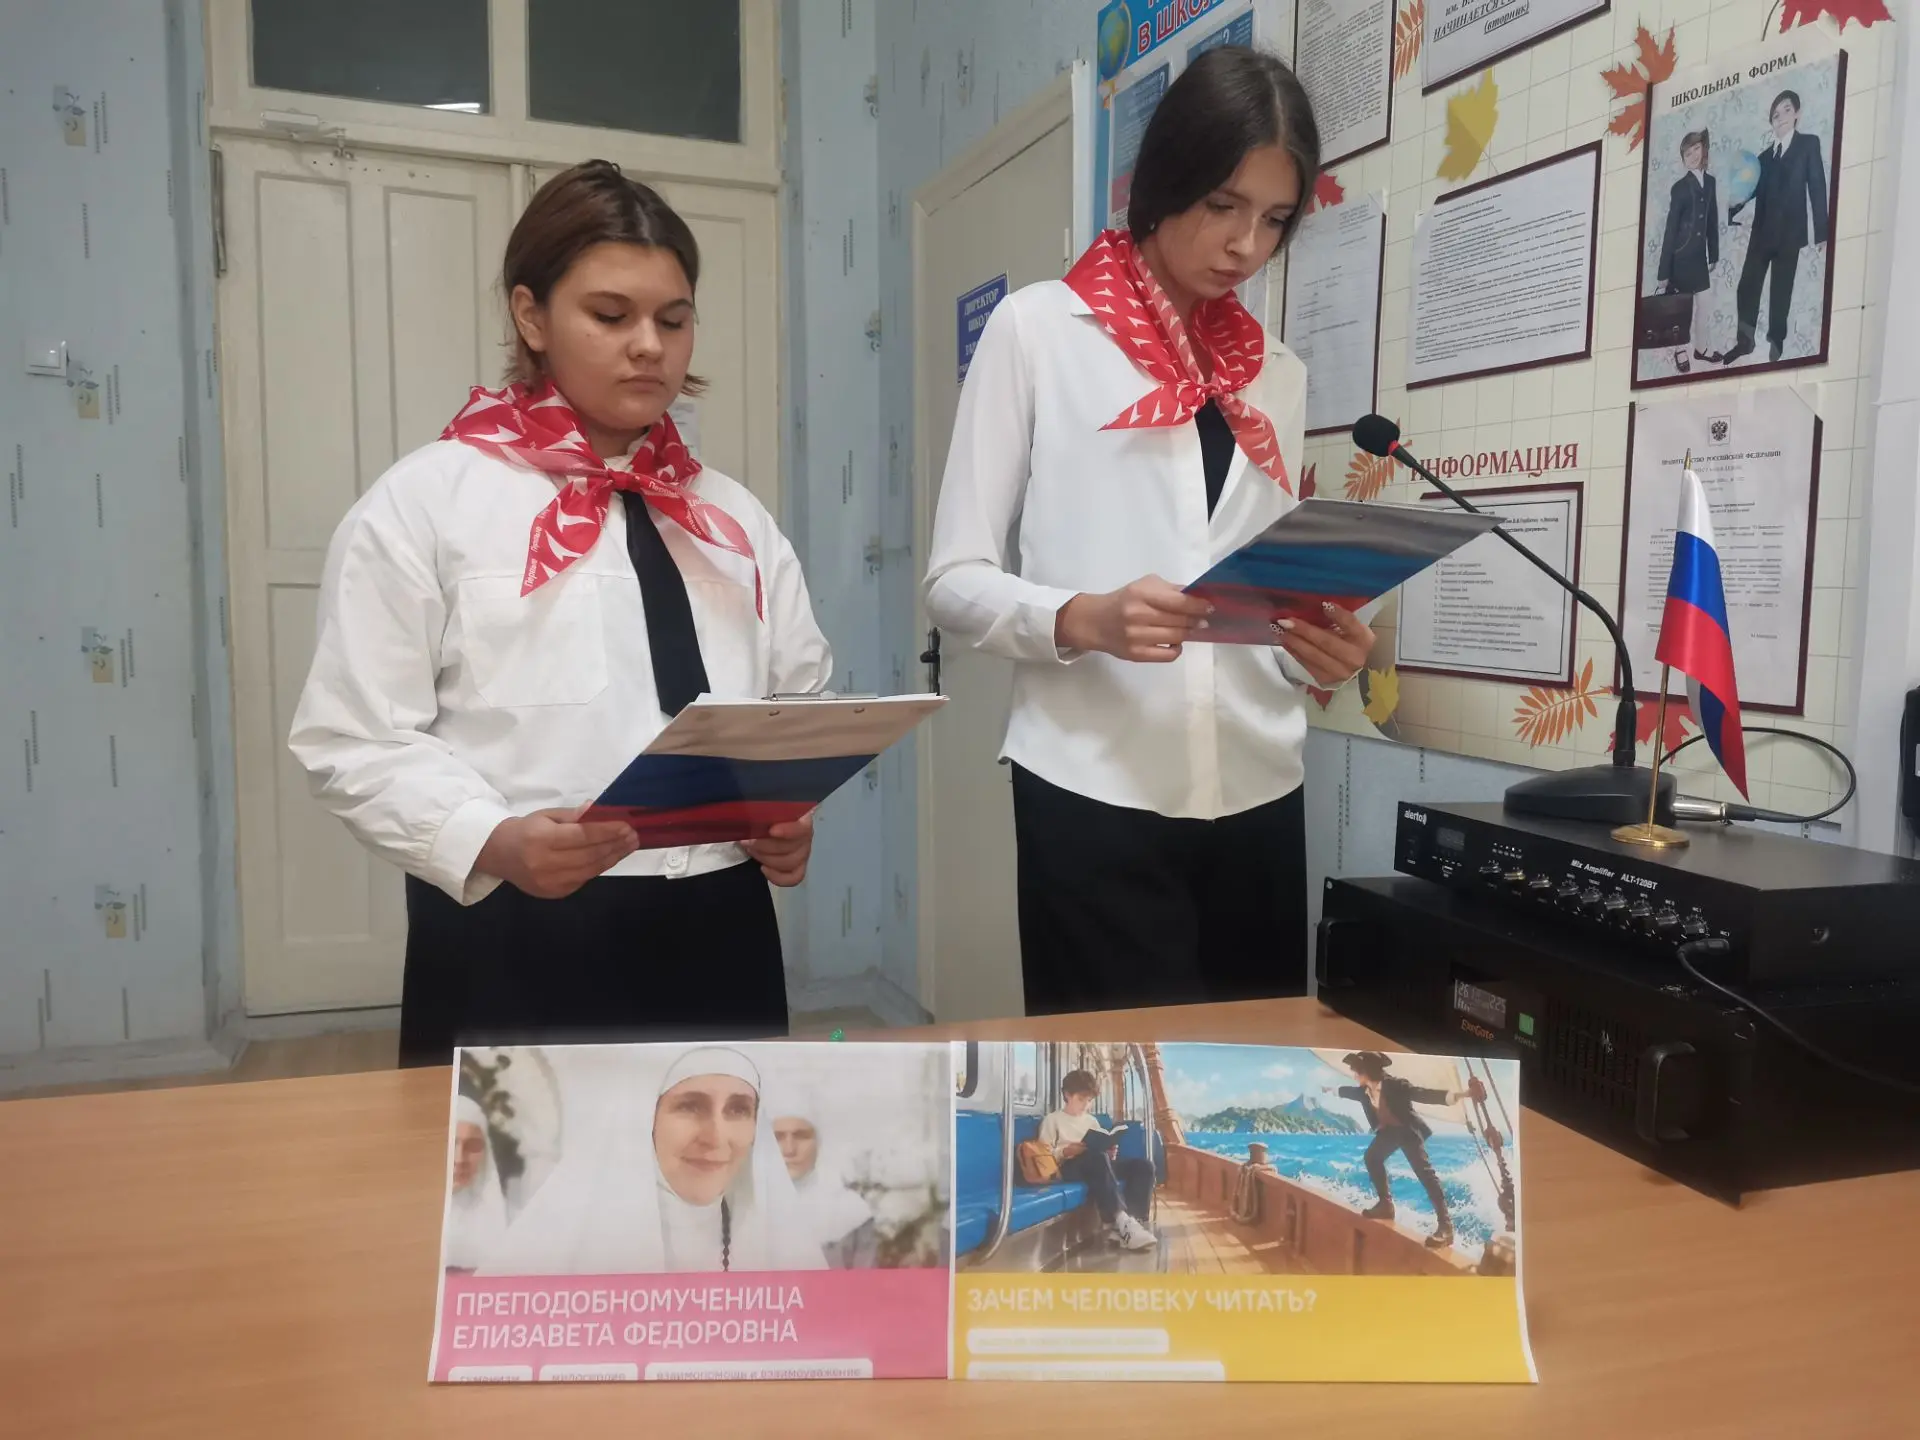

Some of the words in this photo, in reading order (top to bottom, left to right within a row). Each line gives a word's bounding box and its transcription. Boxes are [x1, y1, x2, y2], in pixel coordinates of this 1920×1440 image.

[1138, 21, 1151, 55] В
[1156, 0, 1219, 42] ШКО
[1671, 72, 1740, 107] ШКОЛЬНАЯ
[1748, 52, 1797, 78] ФОРМА
[456, 1286, 804, 1317] ПРЕПОДОБНОМУЧЕНИЦА
[967, 1289, 1054, 1312] ЗАЧЕМ
[1061, 1288, 1199, 1313] ЧЕЛОВЕКУ
[1206, 1289, 1317, 1313] ЧИТАТЬ?
[453, 1323, 616, 1350] ЕЛИЗАВЕТА
[624, 1319, 798, 1347] ФЕДОРОВНА
